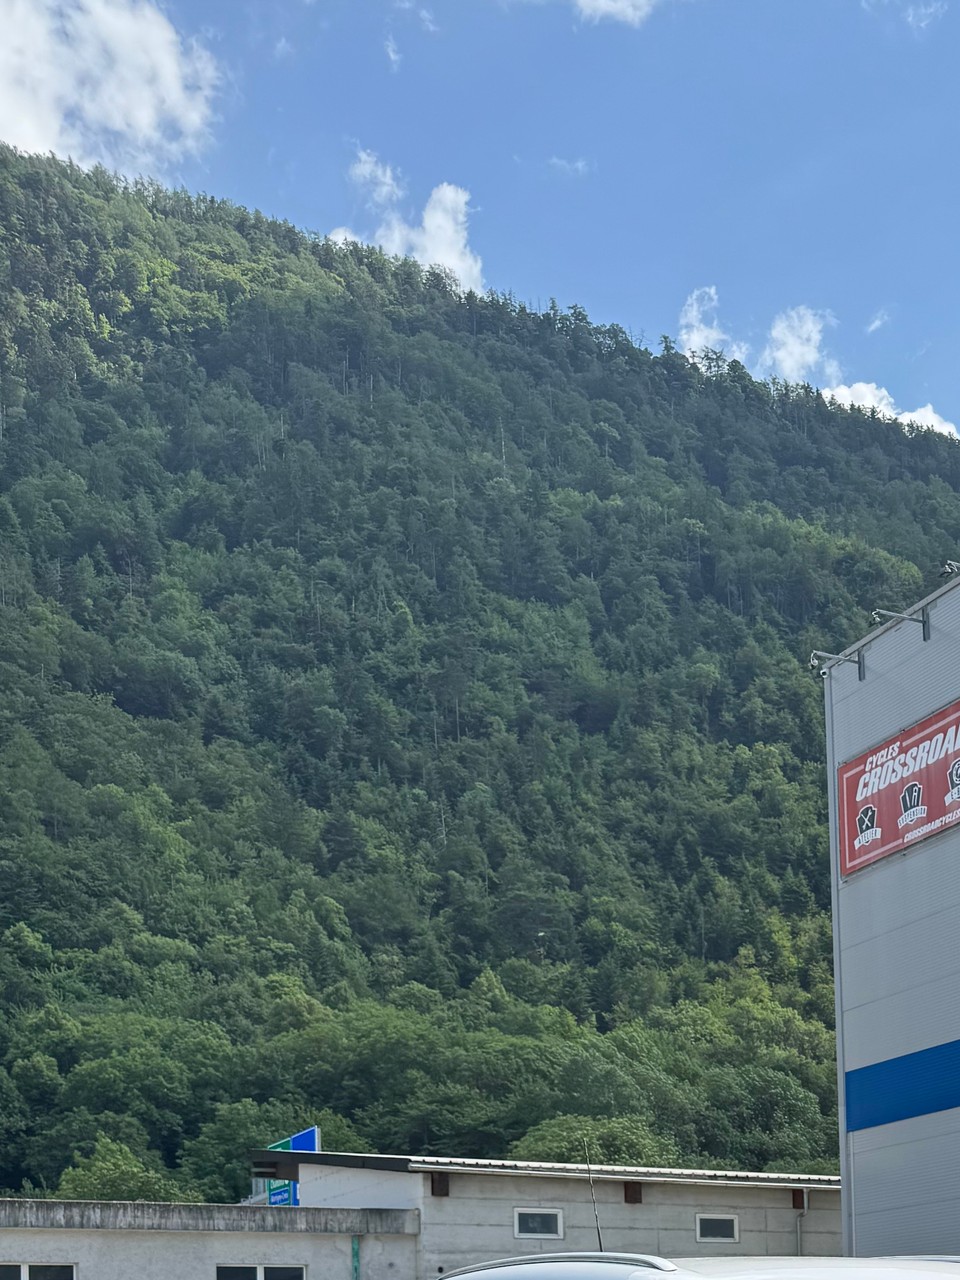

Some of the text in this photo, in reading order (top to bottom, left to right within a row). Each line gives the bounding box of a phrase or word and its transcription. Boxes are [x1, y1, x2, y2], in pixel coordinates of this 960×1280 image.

[865, 741, 900, 772] CYCLES
[898, 806, 926, 826] SUSPENSION
[857, 828, 878, 845] ATELIER
